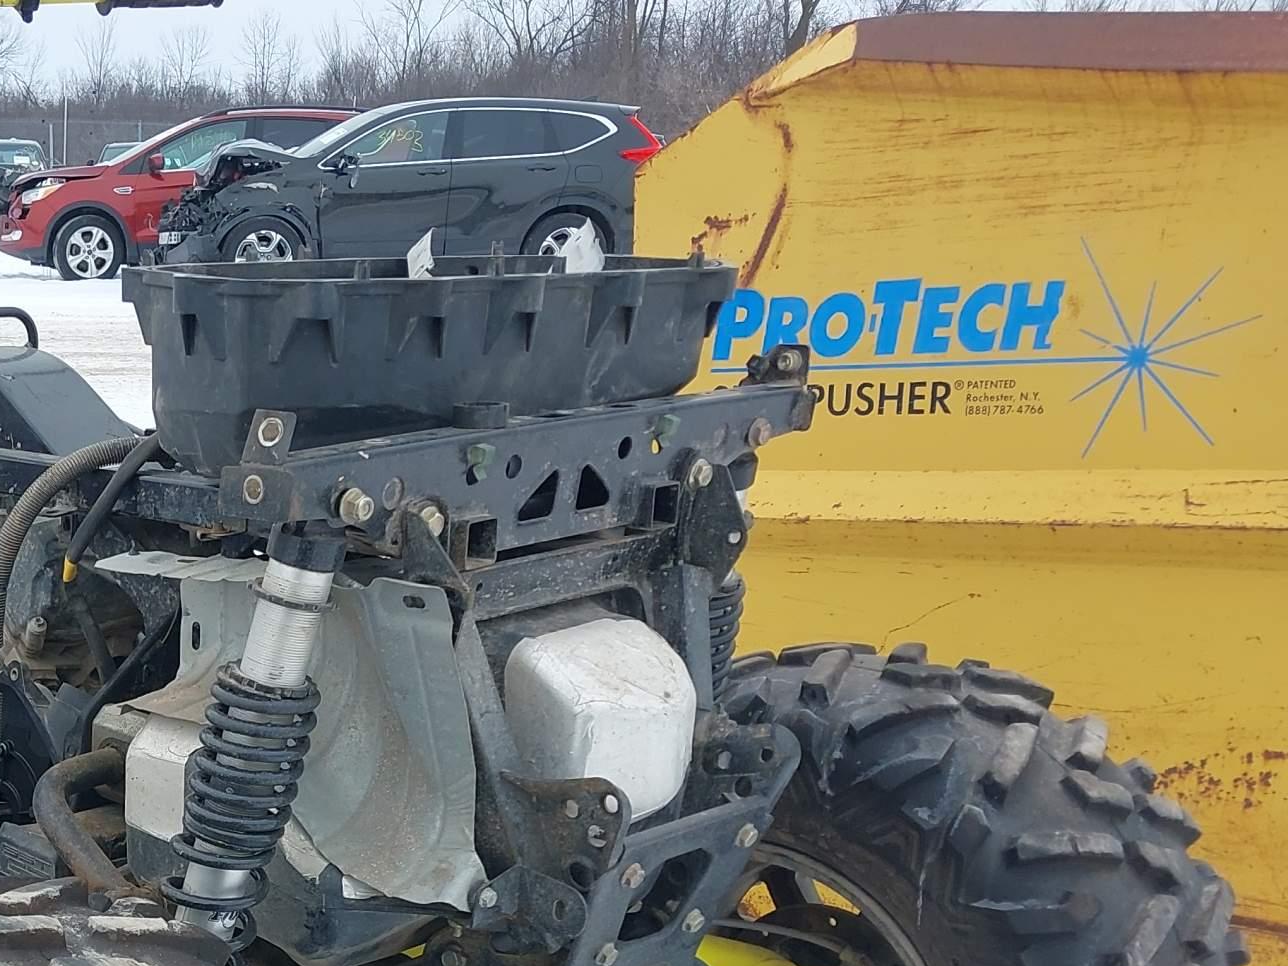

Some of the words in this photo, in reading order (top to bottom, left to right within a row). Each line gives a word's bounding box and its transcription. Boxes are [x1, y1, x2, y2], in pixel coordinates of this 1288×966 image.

[967, 379, 1017, 390] PATENTED
[966, 392, 1016, 404] Rochester,
[964, 404, 991, 417] (888)
